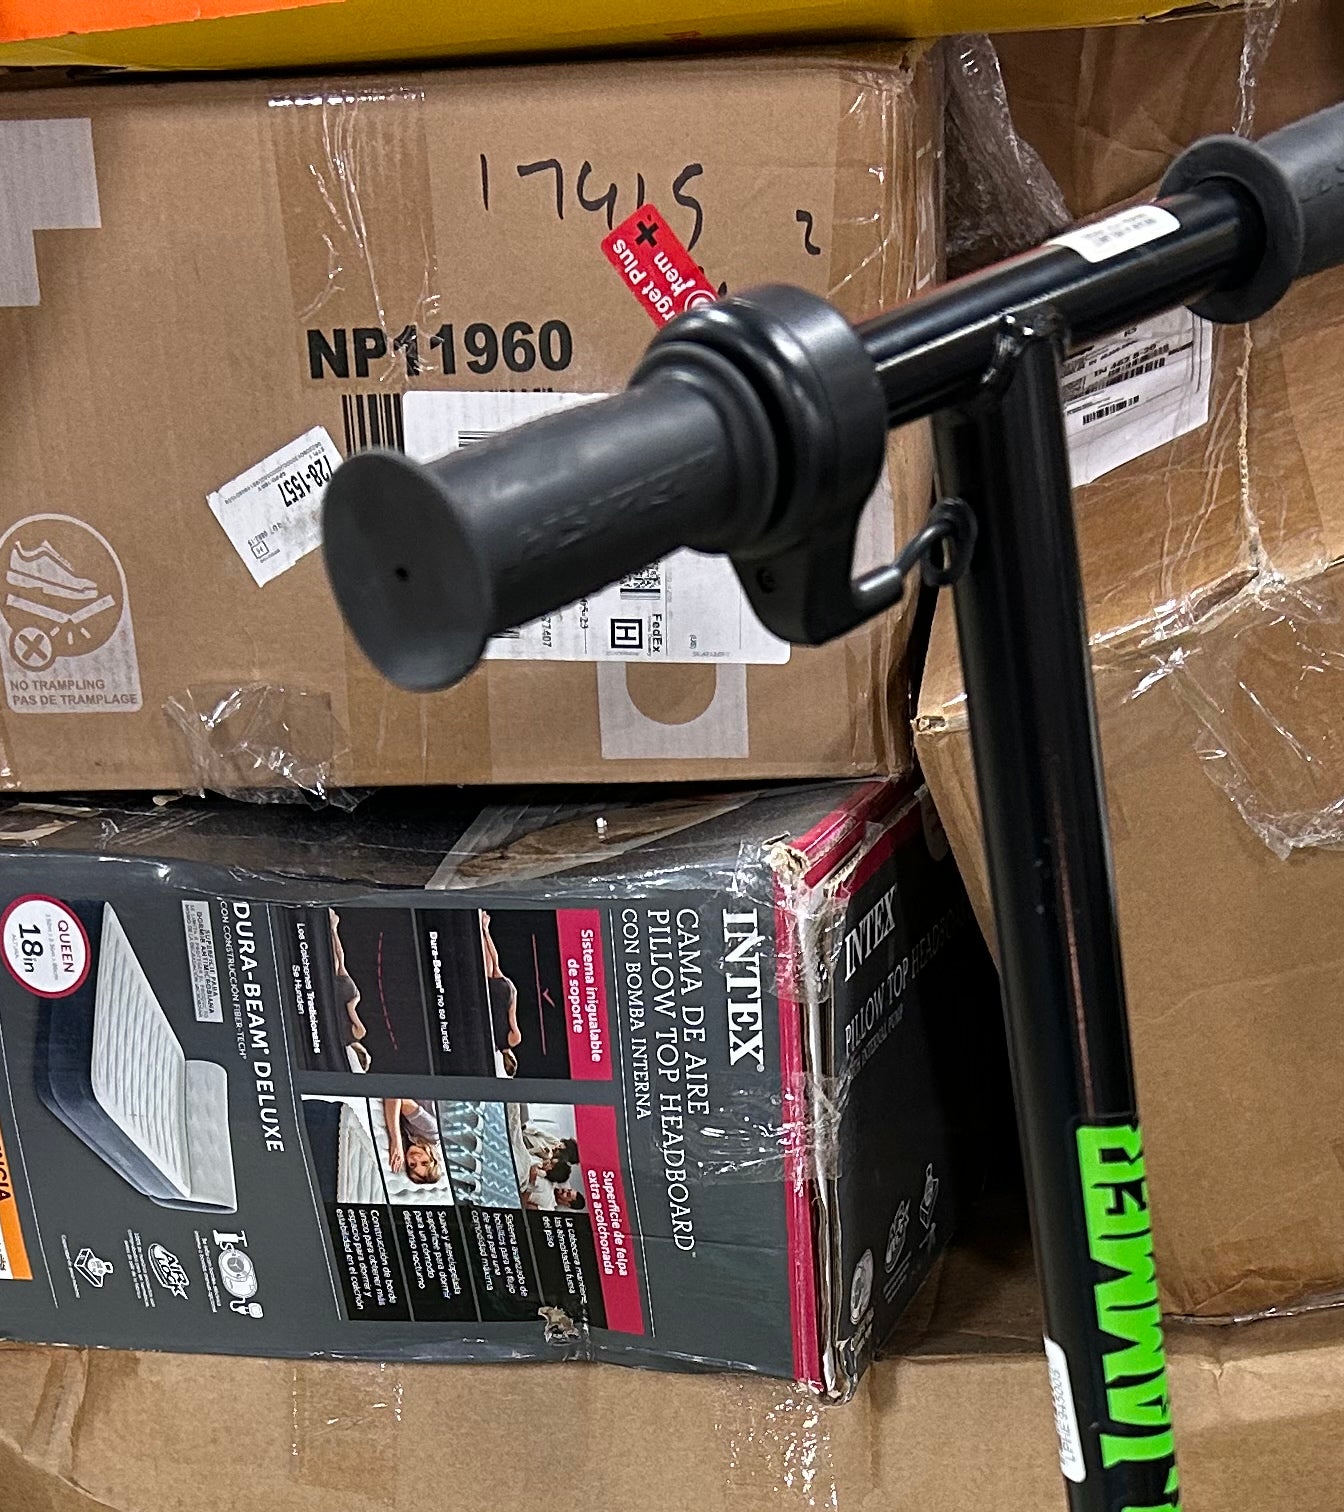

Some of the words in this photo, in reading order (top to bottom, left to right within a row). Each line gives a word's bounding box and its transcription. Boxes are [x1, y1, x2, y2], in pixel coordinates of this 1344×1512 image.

[612, 238, 648, 286] Plus
[642, 281, 677, 321] rget
[306, 319, 573, 380] NP11960
[651, 613, 663, 653] FedEx
[10, 680, 29, 691] NO
[31, 679, 105, 691] TRAMPLING
[13, 695, 38, 706] PAS
[40, 694, 57, 705] DE
[60, 694, 138, 705] TRAMPLAGE
[220, 900, 229, 924] CON
[621, 908, 640, 954] CON
[844, 882, 898, 983] INTEX
[18, 924, 44, 973] 18in
[57, 920, 75, 973] QUEEN
[223, 925, 240, 1001] CONSTRUCCIÓN
[567, 958, 580, 977] de
[581, 929, 594, 984] Sistema
[647, 910, 676, 1017] PILLOW
[676, 908, 702, 995] CAMA
[294, 979, 305, 1015] Hunden
[568, 979, 584, 1033] soporte
[625, 962, 645, 1031] BOMBA
[722, 909, 763, 1064] INTEX
[845, 983, 885, 1054] PILLOW
[887, 957, 909, 1006] TOP
[307, 991, 321, 1054] Tradicionales
[584, 987, 603, 1062] inigualable
[681, 1006, 706, 1042] DE
[631, 1038, 651, 1119] INTERNA
[655, 1027, 680, 1082] TOP
[254, 1061, 284, 1151] DELUXE
[684, 1052, 710, 1114] AIRE
[587, 1169, 601, 1200] extra
[660, 1094, 694, 1250] HEADBOARD
[602, 1171, 622, 1229] Superficie
[593, 1201, 617, 1275] acolchonada
[613, 1230, 625, 1246] de
[615, 1247, 628, 1276] felpa
[1076, 1123, 1181, 1491] JAMMER
